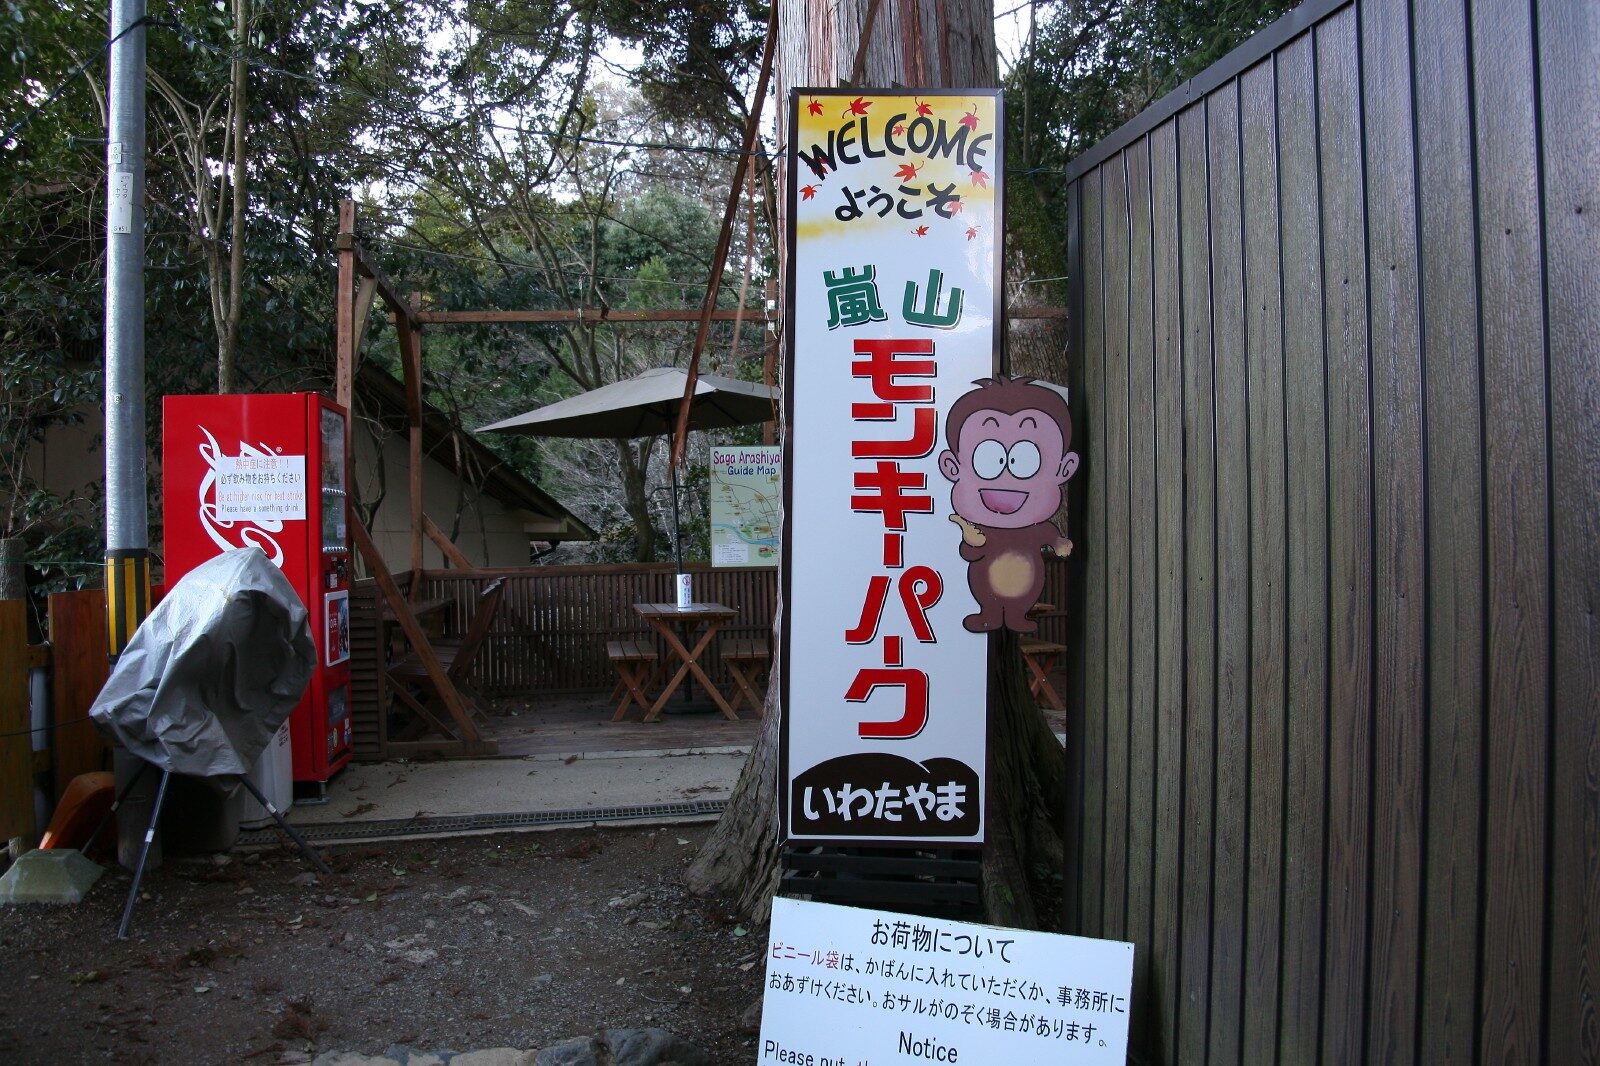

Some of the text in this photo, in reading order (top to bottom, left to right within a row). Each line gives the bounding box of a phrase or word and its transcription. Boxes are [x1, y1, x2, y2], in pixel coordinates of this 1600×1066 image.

[798, 113, 993, 181] WELCOME
[834, 182, 961, 222] ようこそ
[823, 264, 964, 331] 嵐山
[713, 450, 736, 466] Saga
[727, 465, 777, 477] Guide Map
[221, 504, 238, 513] Please
[844, 338, 944, 740] モンキーパーク
[803, 781, 967, 822] いわたやま
[871, 918, 1015, 964] お荷物について
[764, 1039, 815, 1066] Please
[898, 1030, 958, 1063] Notice
